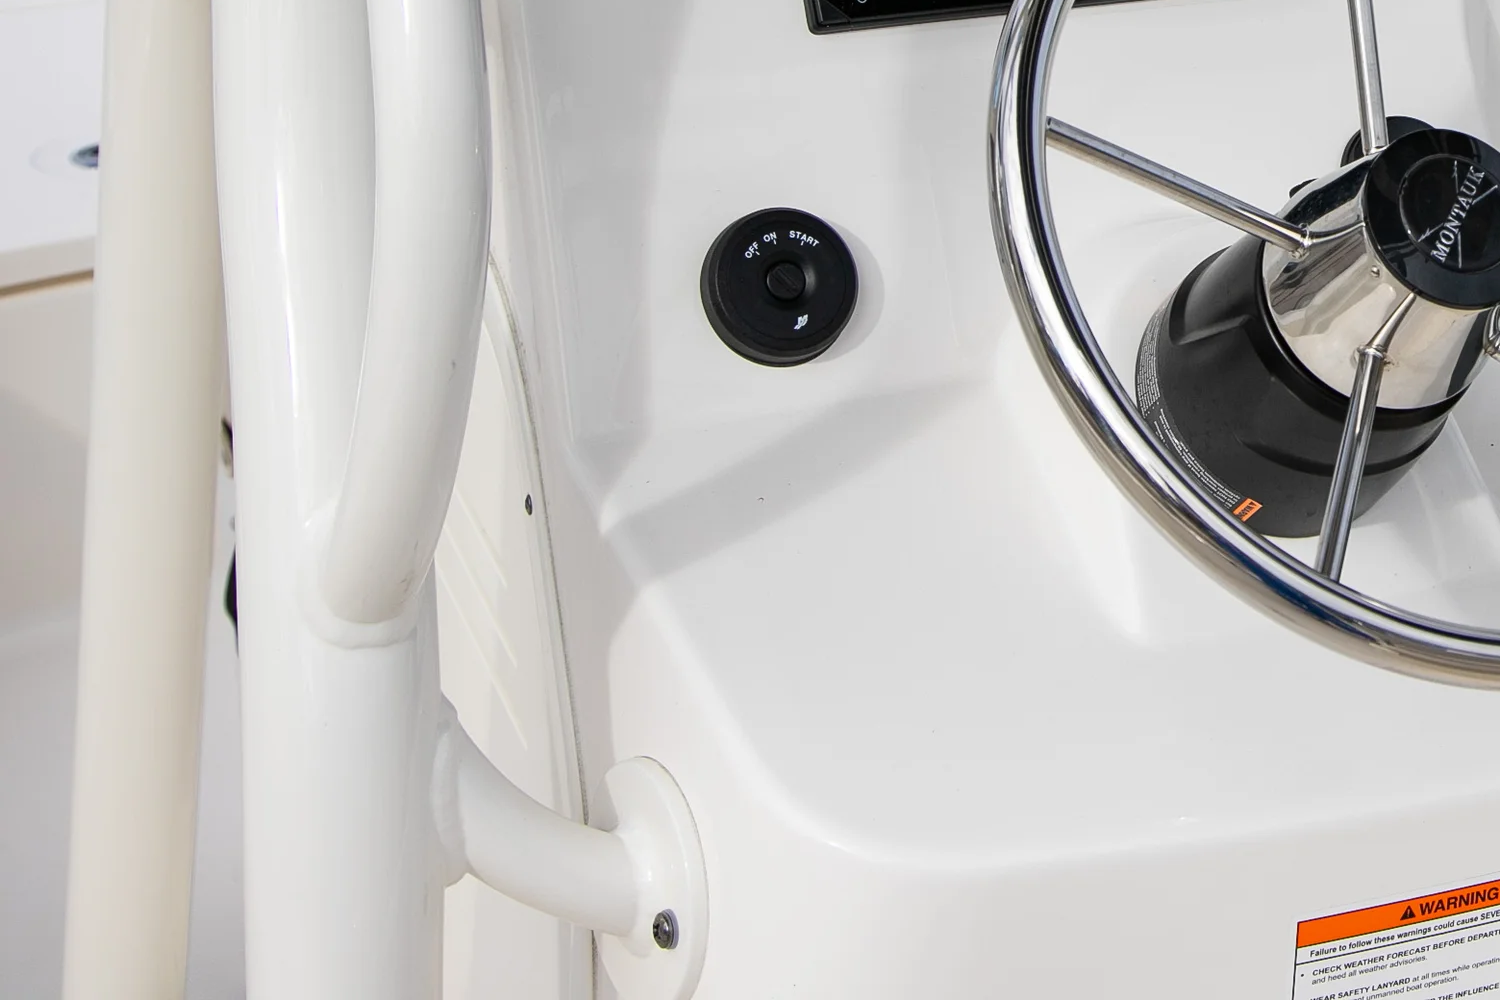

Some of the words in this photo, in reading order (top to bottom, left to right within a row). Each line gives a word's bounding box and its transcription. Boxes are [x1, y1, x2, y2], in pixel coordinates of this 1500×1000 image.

[1430, 166, 1485, 263] MONTAUK
[744, 241, 759, 259] OFF
[763, 231, 777, 243] ON
[789, 230, 820, 247] START
[1419, 886, 1499, 916] WARNING
[1309, 945, 1336, 957] Failure
[1338, 943, 1346, 951] to
[1348, 937, 1372, 949] follow
[1374, 932, 1395, 943] these
[1396, 924, 1431, 940] warnings
[1433, 919, 1454, 930] could
[1456, 915, 1478, 925] cause
[1311, 976, 1325, 985] and
[1327, 971, 1346, 981] heed
[1348, 969, 1356, 977] all
[1358, 963, 1387, 974] weather
[1389, 954, 1427, 968] advisories.
[1312, 964, 1341, 976] CHECK
[1343, 955, 1384, 969] WEATHER
[1386, 945, 1430, 960] FORECAST
[1432, 937, 1464, 949] BEFORE
[1337, 986, 1369, 998] SAFETY
[1371, 977, 1410, 991] LANYARD
[1431, 968, 1450, 978] times
[1452, 963, 1469, 973] while
[1366, 987, 1404, 1000] unmanned
[1406, 983, 1422, 991] boat
[1423, 974, 1459, 989] operation.
[1455, 982, 1499, 998] INFLUENCE
